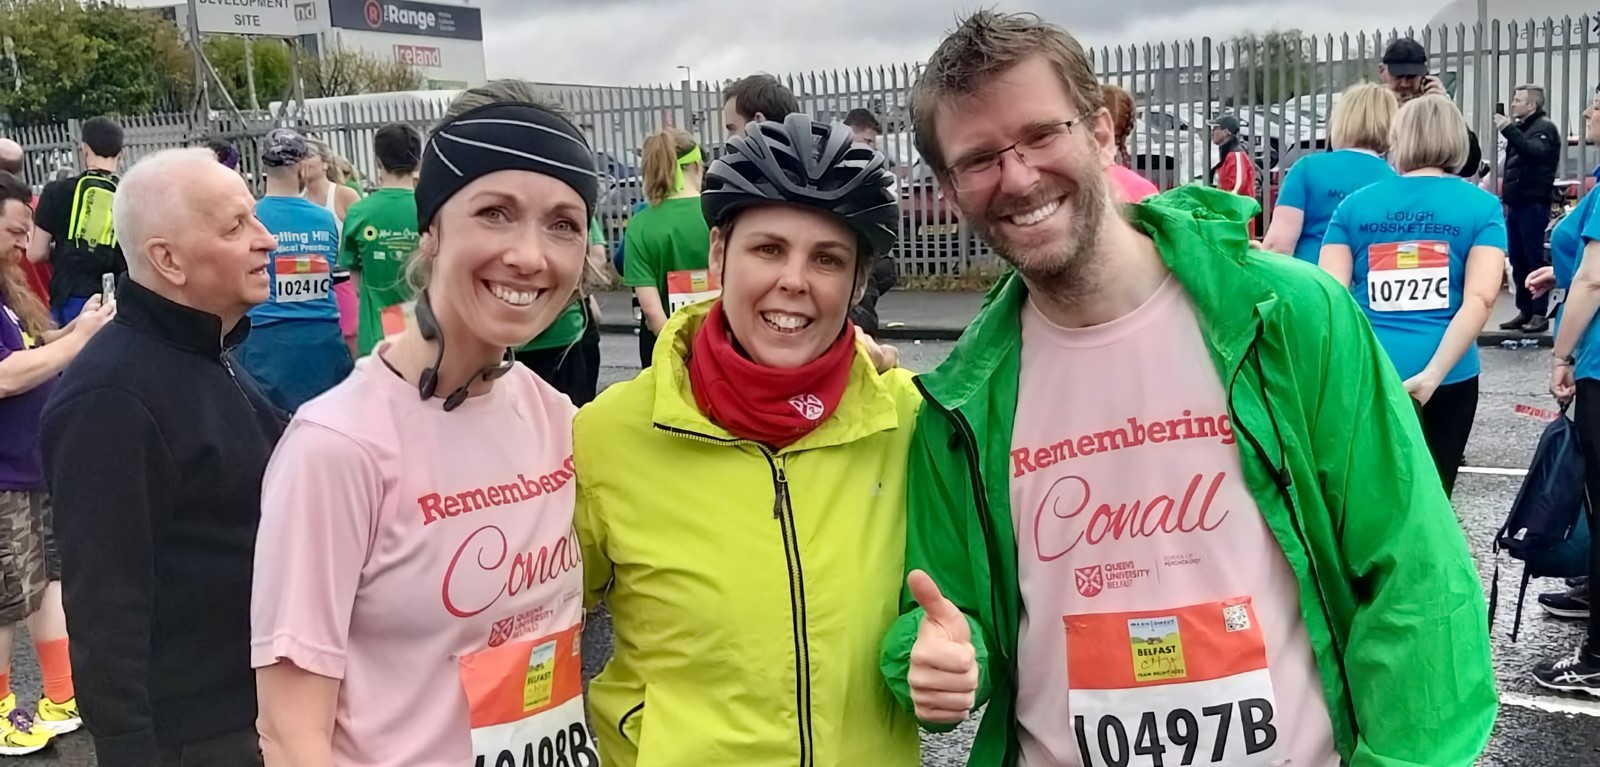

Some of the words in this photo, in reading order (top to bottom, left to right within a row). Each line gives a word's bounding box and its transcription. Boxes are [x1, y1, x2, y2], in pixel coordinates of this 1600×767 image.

[234, 14, 261, 27] SITE
[388, 5, 436, 30] Range
[1386, 210, 1434, 222] LOUGH
[1359, 222, 1461, 237] MOSSKETEERS
[278, 278, 330, 297] 10241C
[1371, 277, 1448, 302] 10727C
[1010, 409, 1236, 478] Remembering
[1034, 471, 1229, 562] Conall
[1137, 645, 1176, 657] BELFAST
[1074, 697, 1278, 767] 10497B
